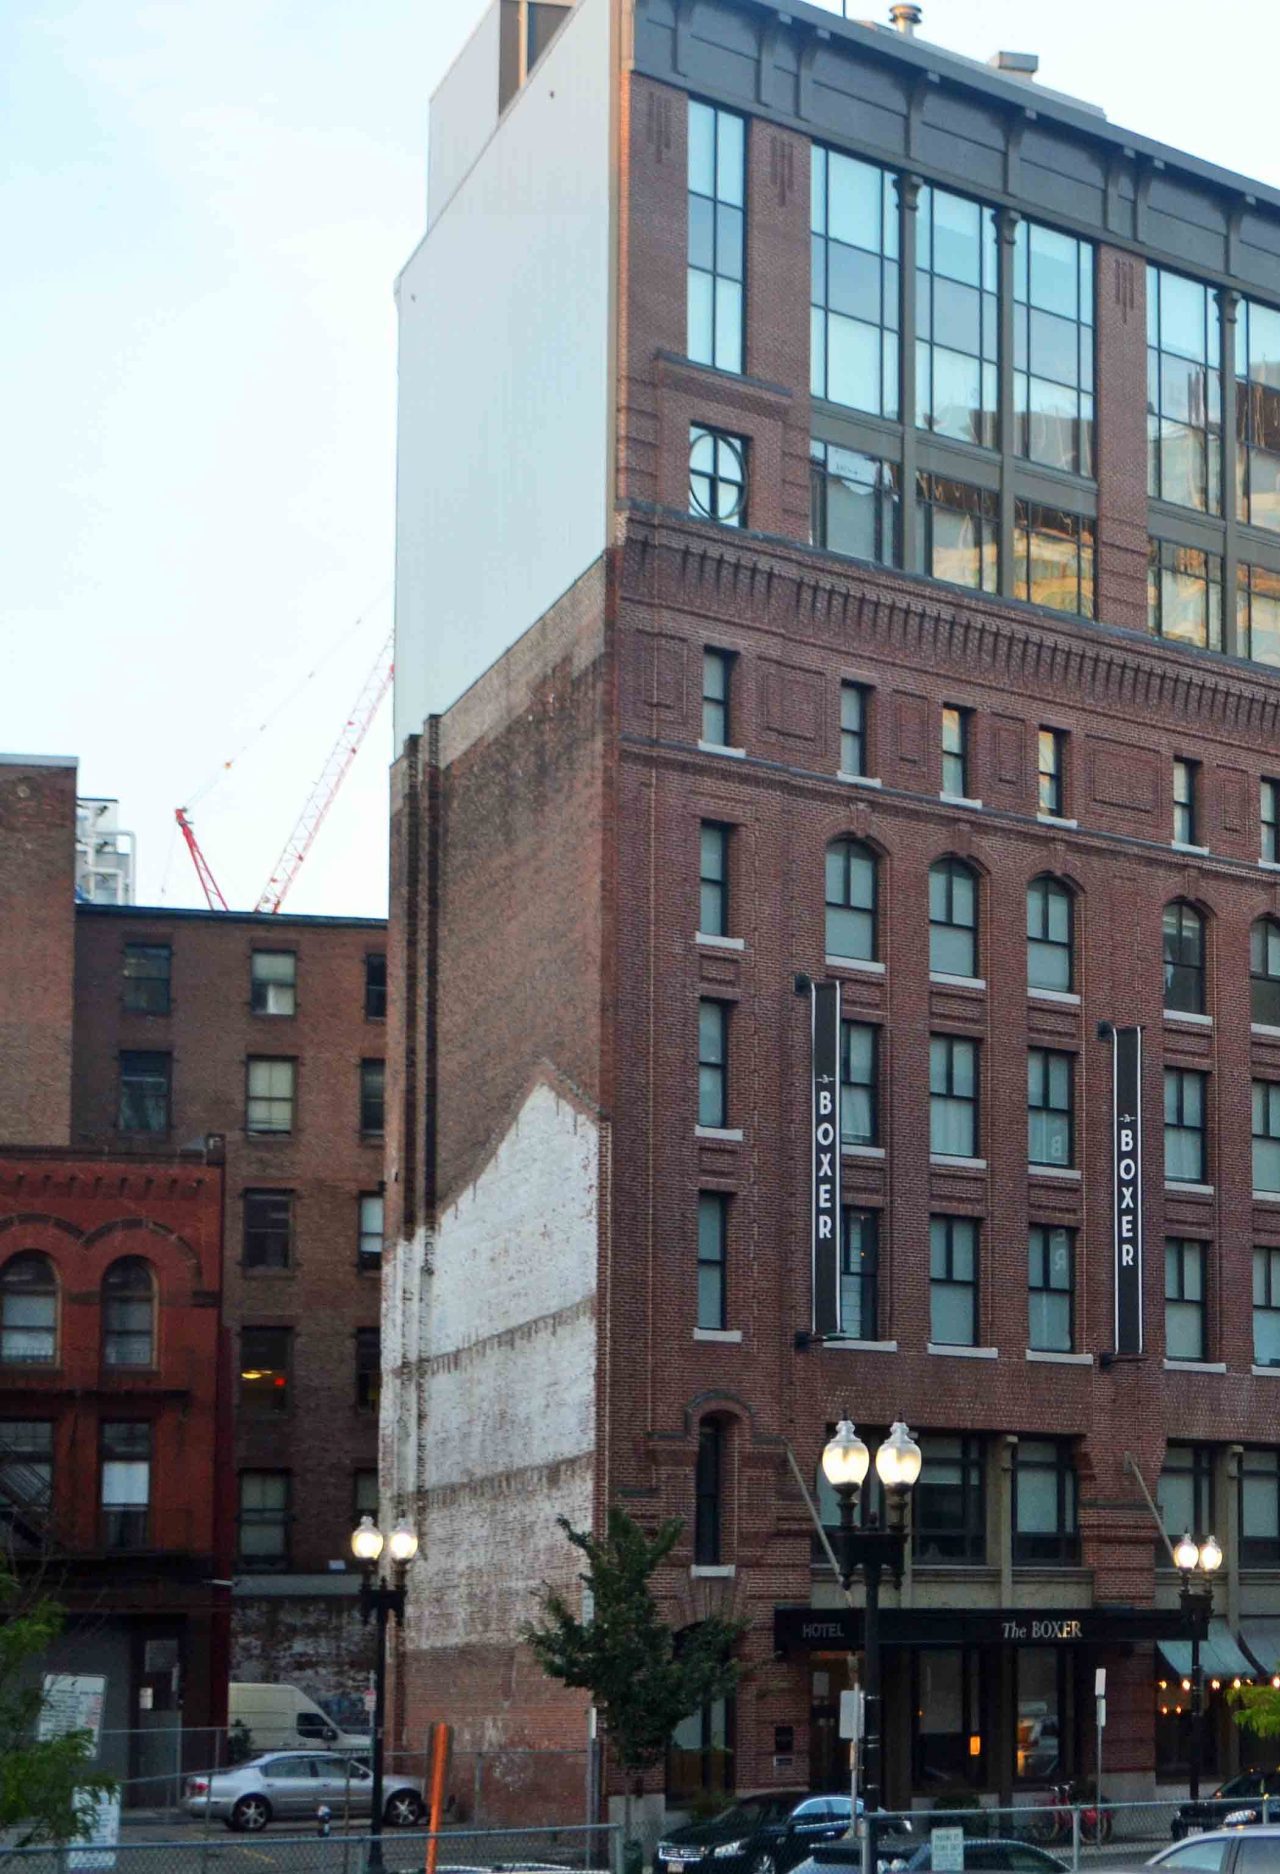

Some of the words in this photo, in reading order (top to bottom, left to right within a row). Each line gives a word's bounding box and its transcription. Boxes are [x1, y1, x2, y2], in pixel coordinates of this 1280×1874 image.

[817, 1091, 834, 1238] BOXER
[1119, 1129, 1136, 1266] BOXER
[802, 1622, 845, 1638] HOTEL
[1002, 1621, 1027, 1638] The
[1031, 1620, 1083, 1638] BOXER
